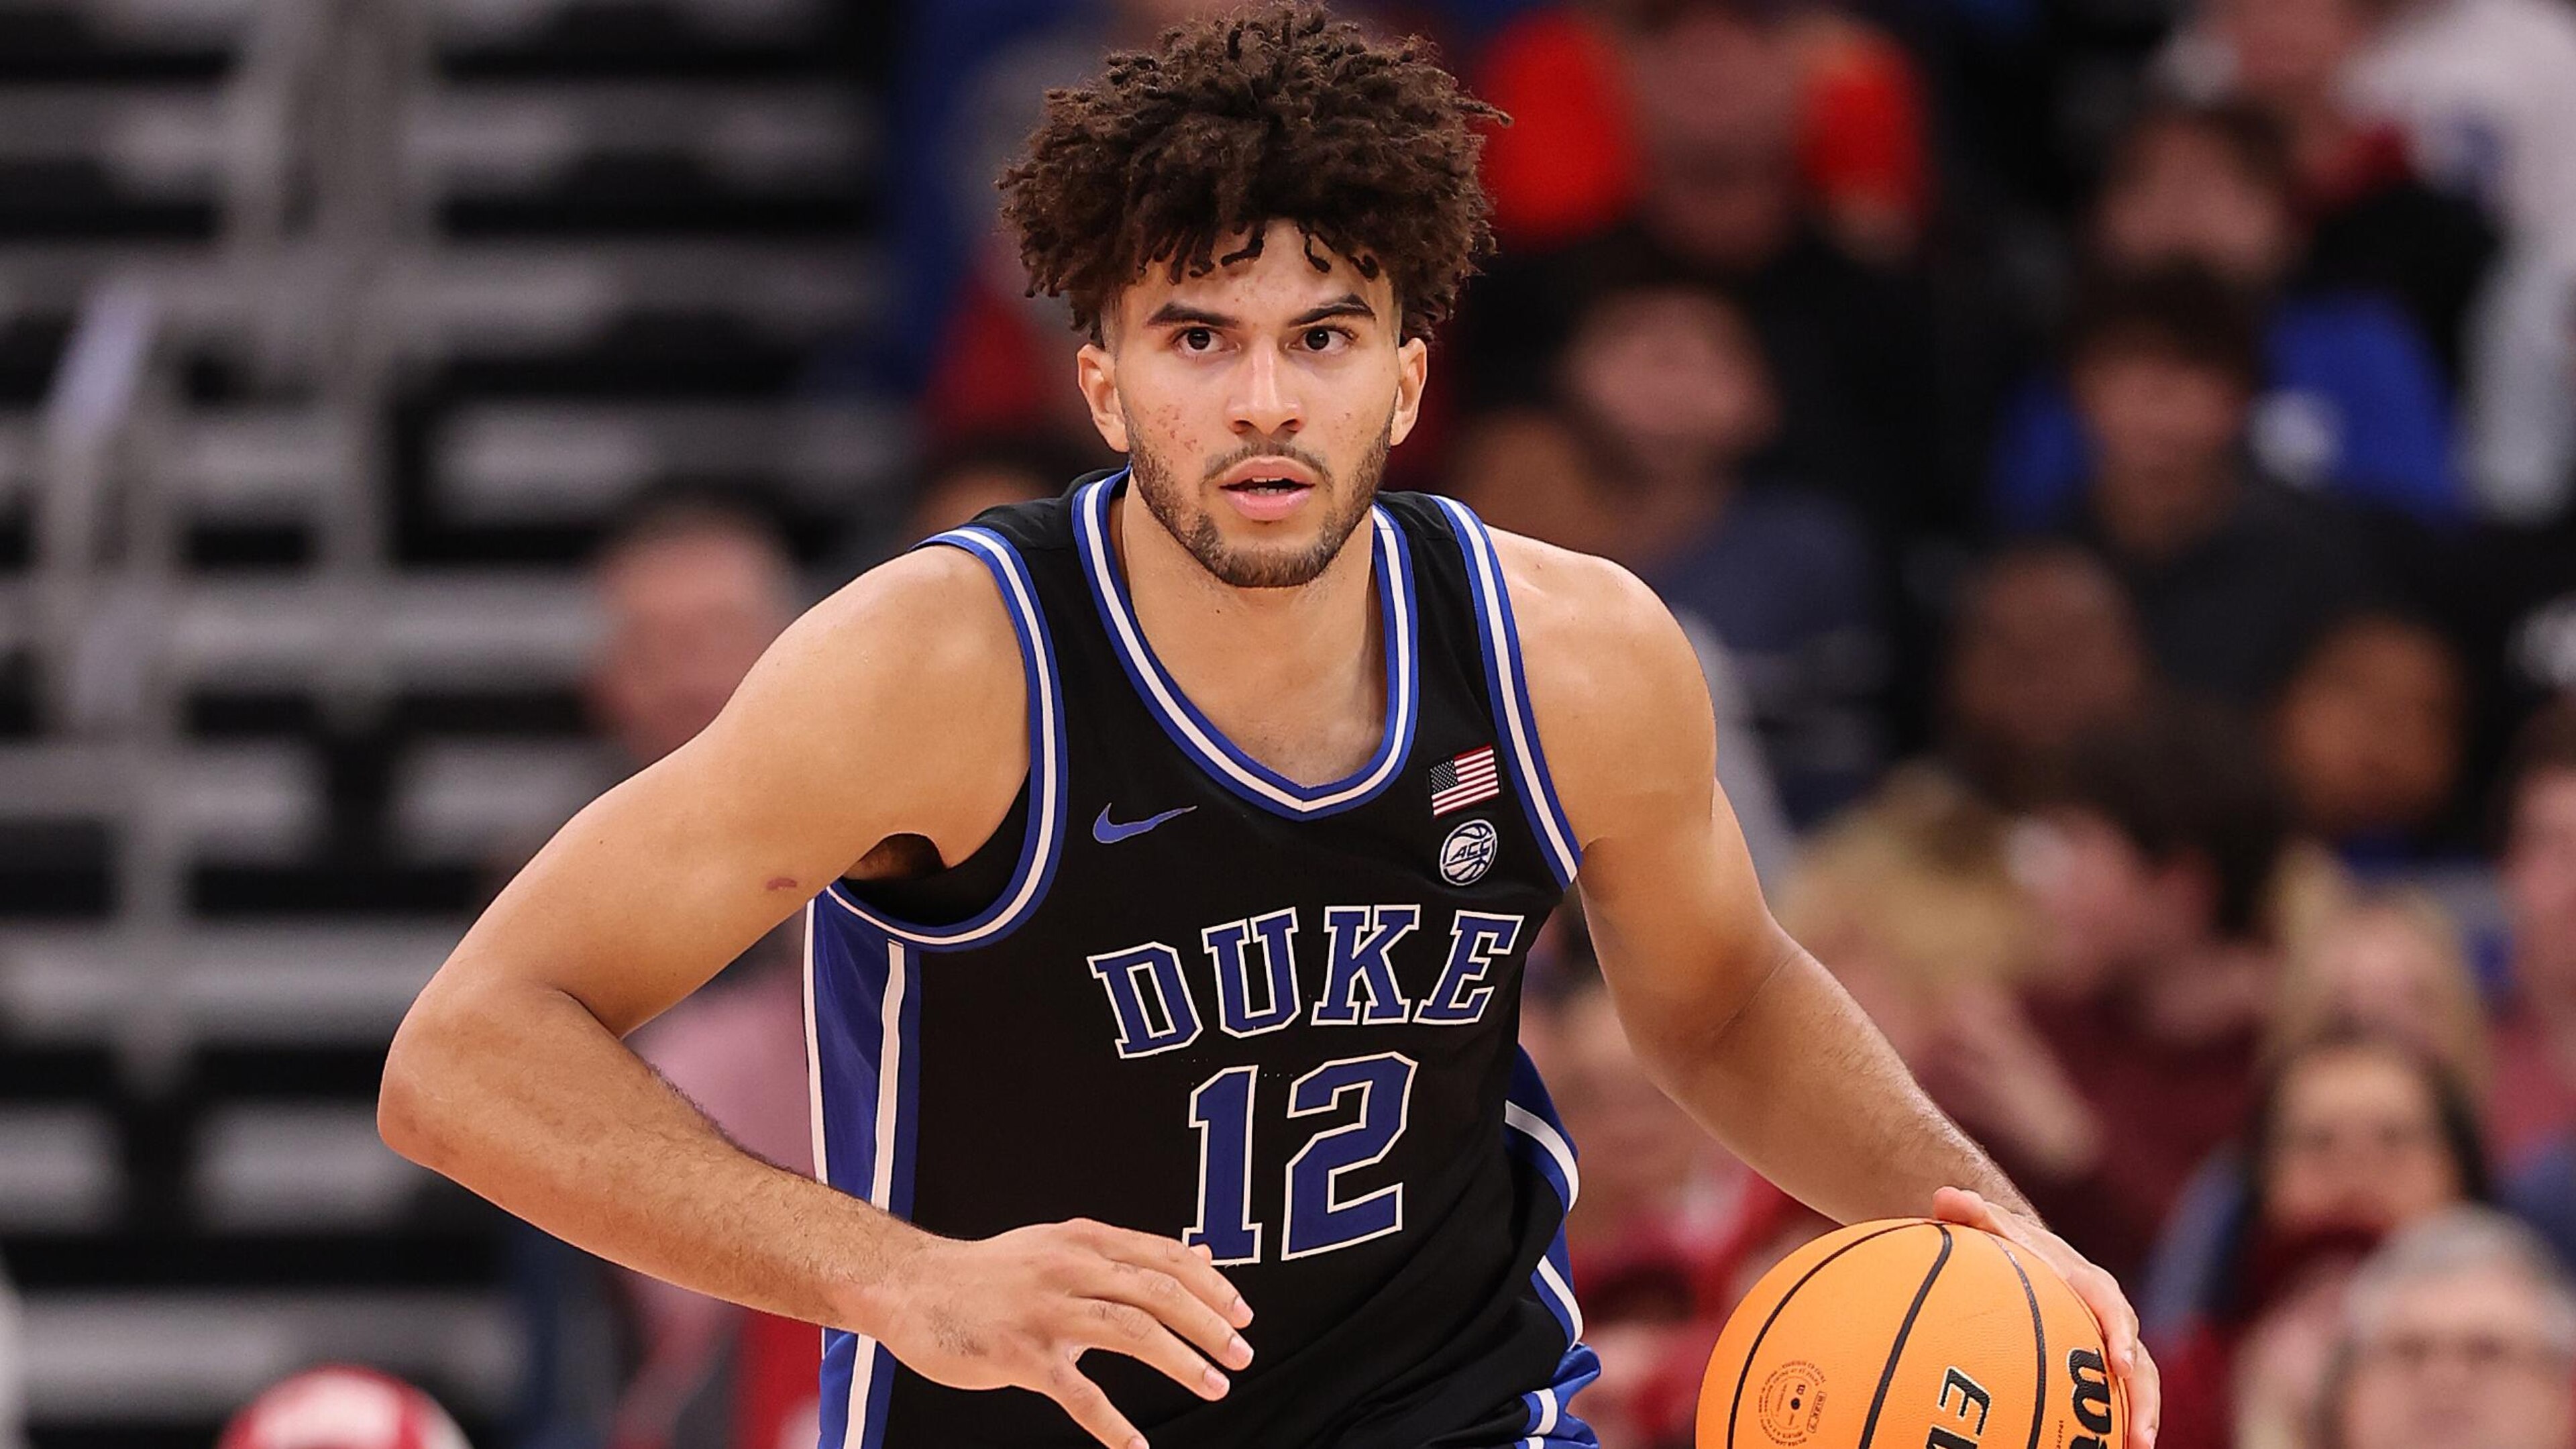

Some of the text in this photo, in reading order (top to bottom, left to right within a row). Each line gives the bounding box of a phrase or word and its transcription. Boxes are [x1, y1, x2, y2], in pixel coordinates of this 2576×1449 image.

[1450, 838, 1493, 862] ACC
[1086, 904, 1525, 1059] DUKE
[1182, 1051, 1418, 1265] 12
